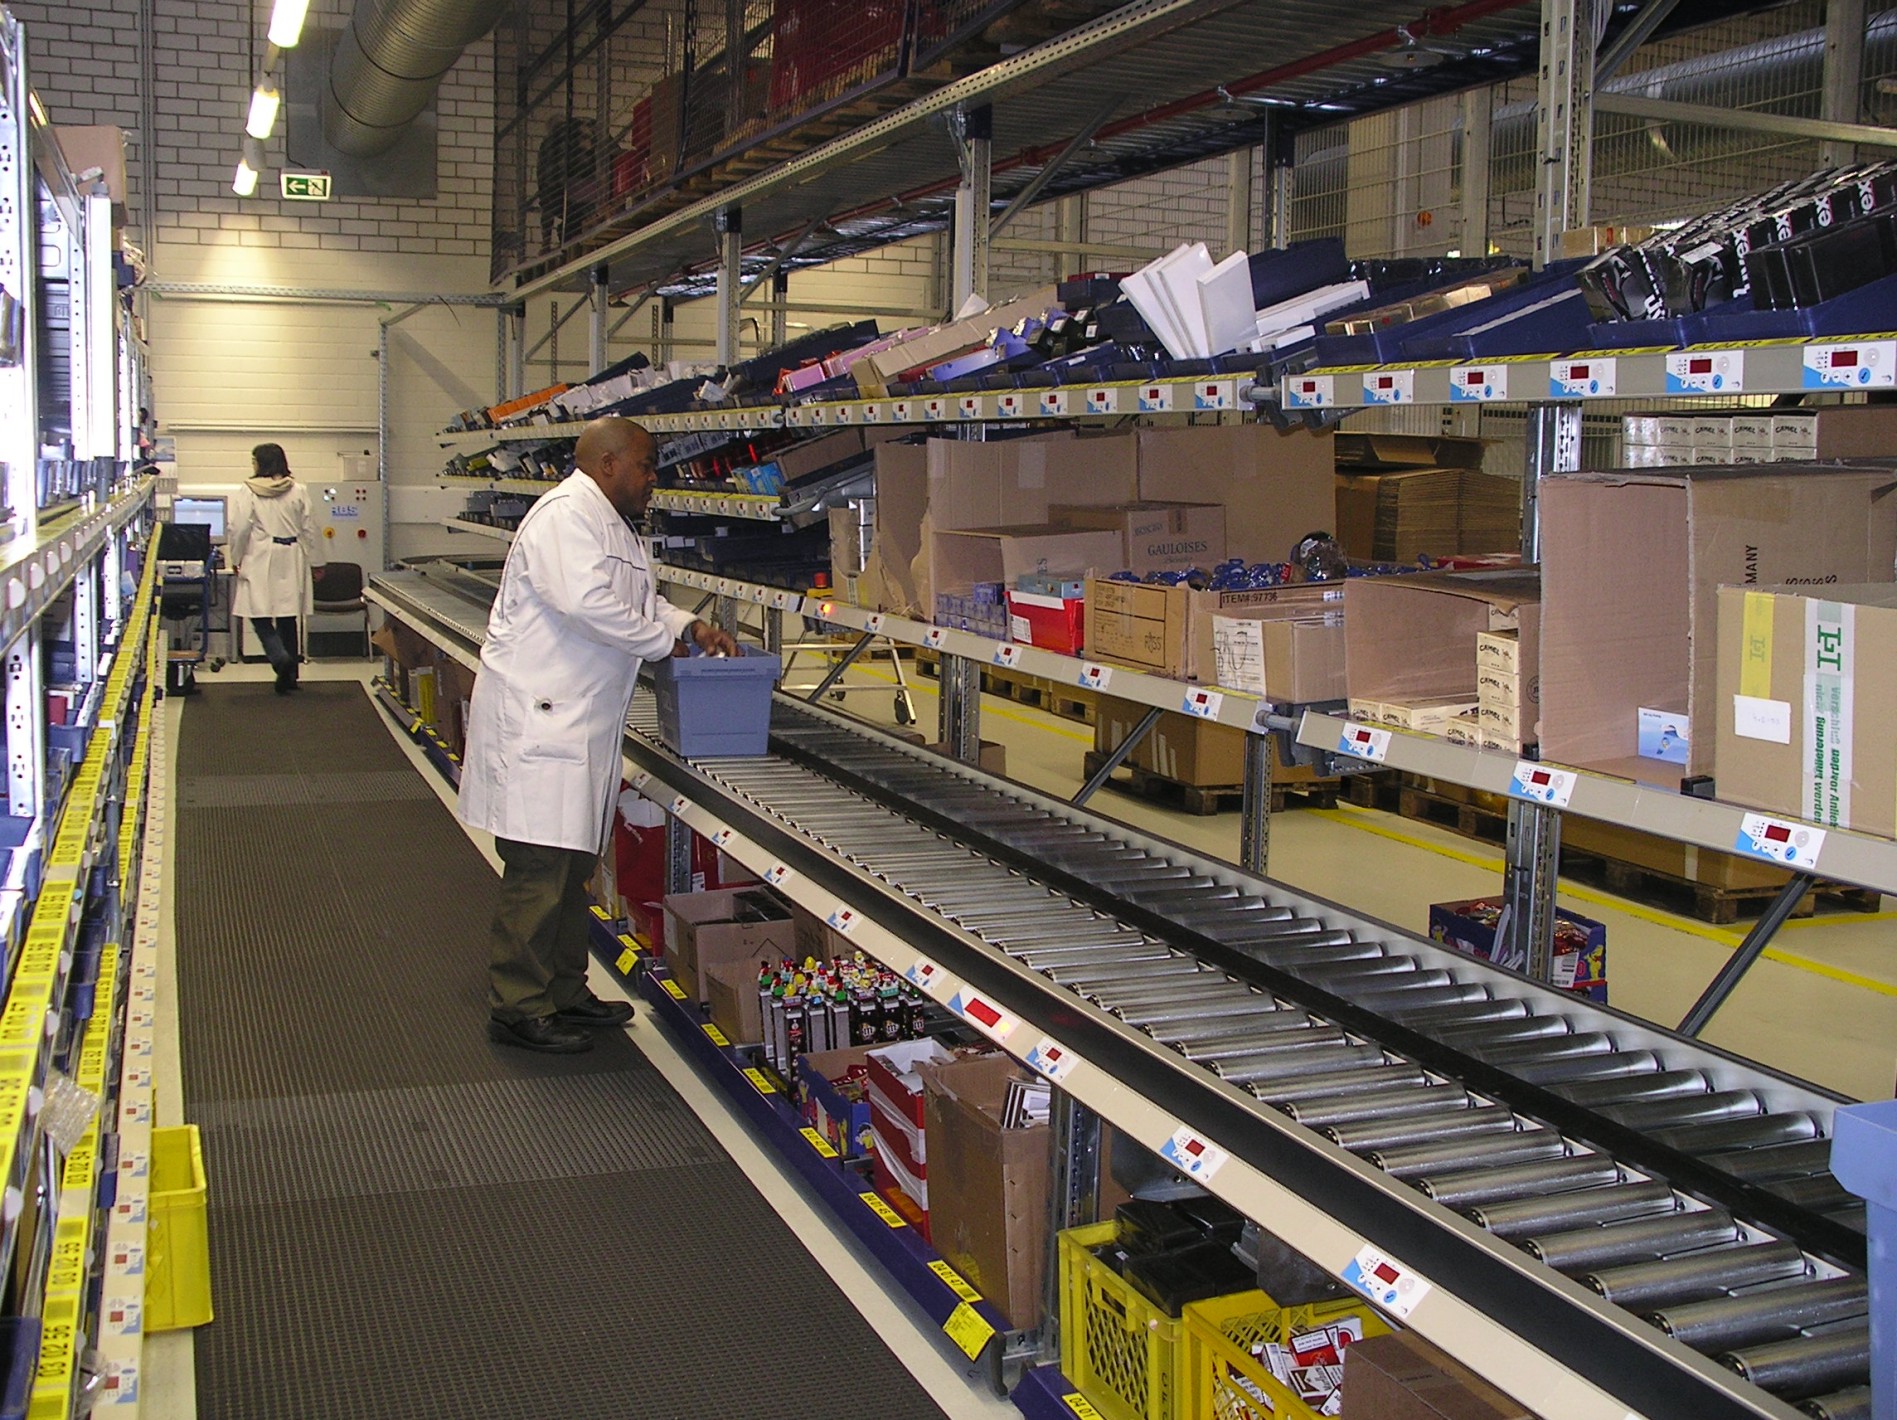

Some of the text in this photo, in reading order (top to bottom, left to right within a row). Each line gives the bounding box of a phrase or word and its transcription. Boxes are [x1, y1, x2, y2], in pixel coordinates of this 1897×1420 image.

[1734, 426, 1756, 434] CAMEL
[1775, 425, 1798, 434] CAMEL
[1148, 541, 1207, 556] GAULOISES
[1480, 644, 1500, 655] CAMEL
[1480, 676, 1500, 688] CAMEL
[1481, 709, 1500, 721] CAMEL
[54, 1257, 79, 1270] 02
[52, 1271, 76, 1285] 03
[38, 1324, 71, 1378] 03 02 56
[1069, 1393, 1086, 1410] 04
